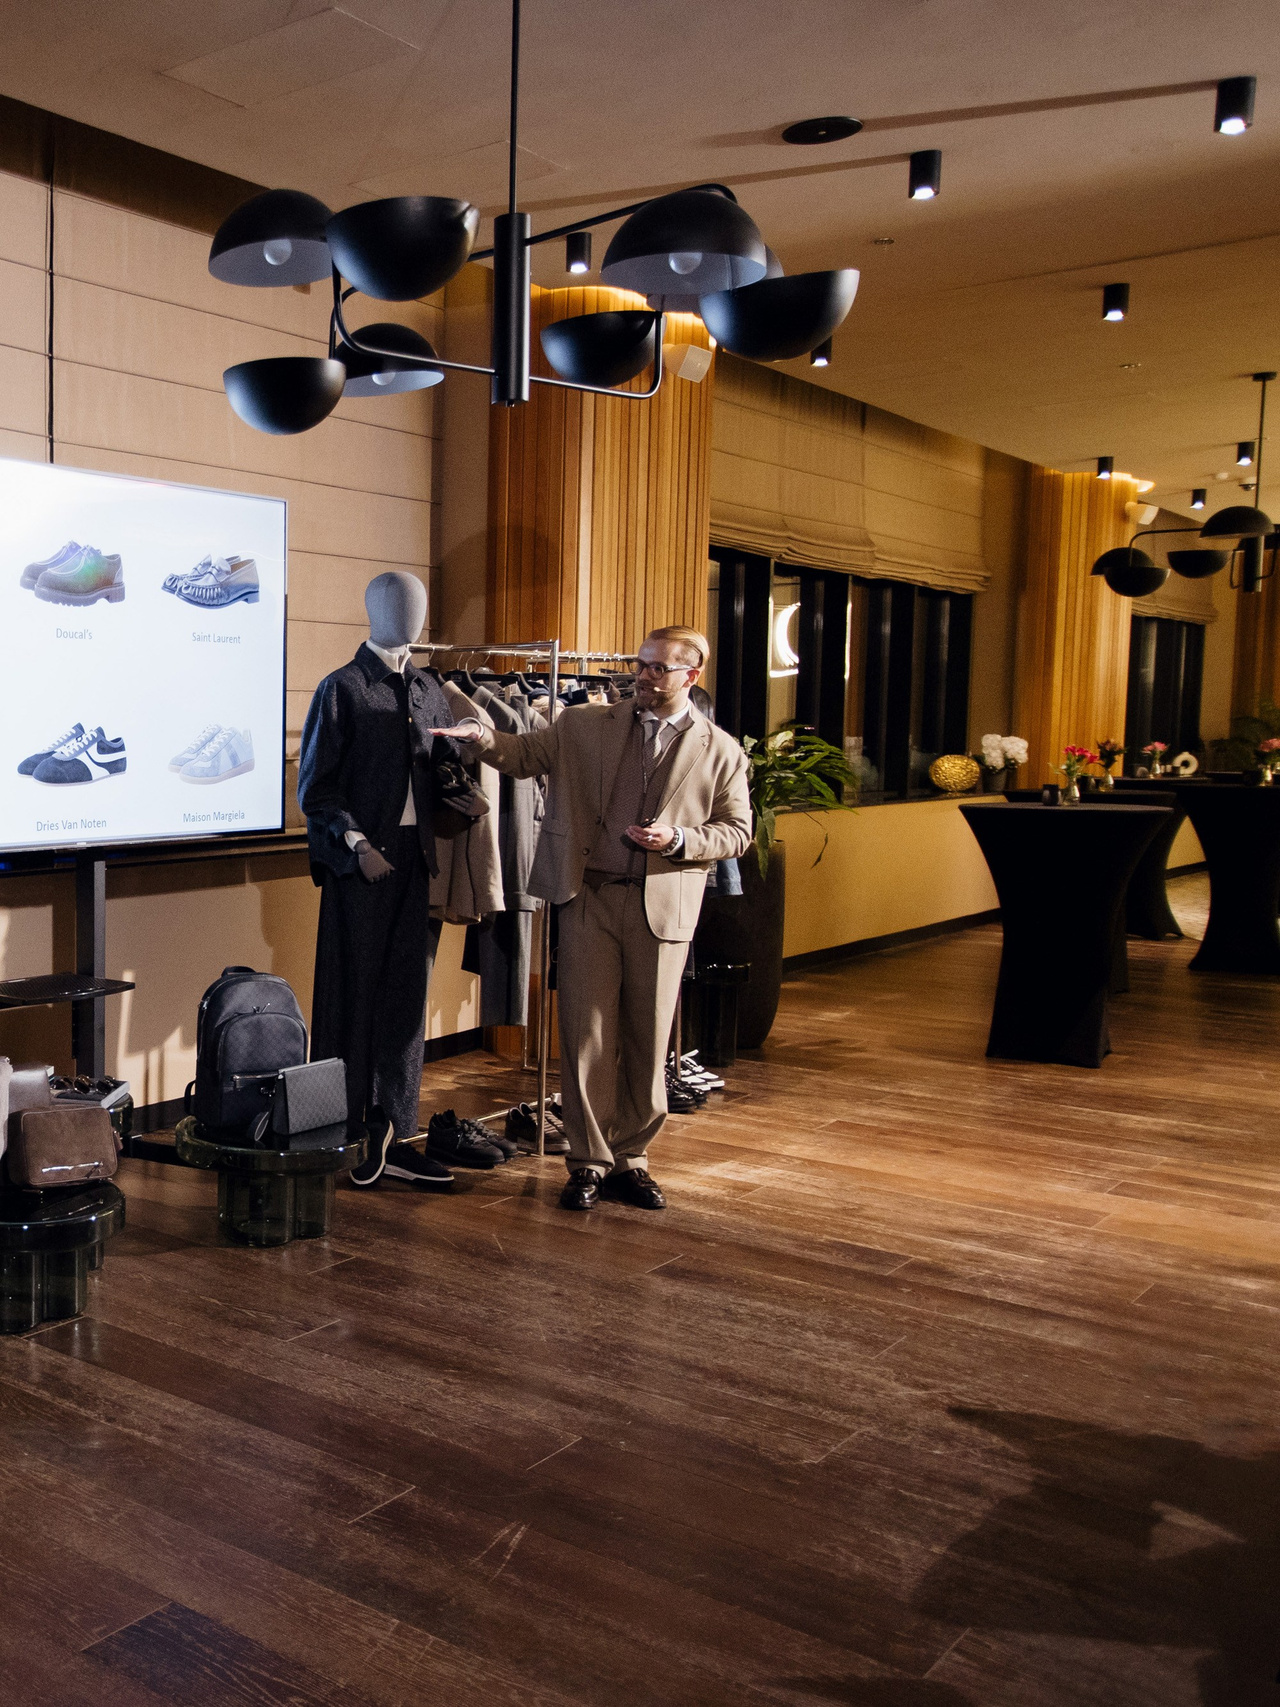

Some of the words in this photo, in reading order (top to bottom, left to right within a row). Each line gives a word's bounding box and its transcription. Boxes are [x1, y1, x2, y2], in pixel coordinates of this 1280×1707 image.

[192, 632, 211, 643] Saint
[213, 633, 241, 644] Laurent
[183, 812, 211, 823] Maison
[213, 810, 245, 822] Margiela
[36, 820, 59, 831] Dries
[61, 820, 78, 830] Van
[80, 819, 107, 829] Noten
